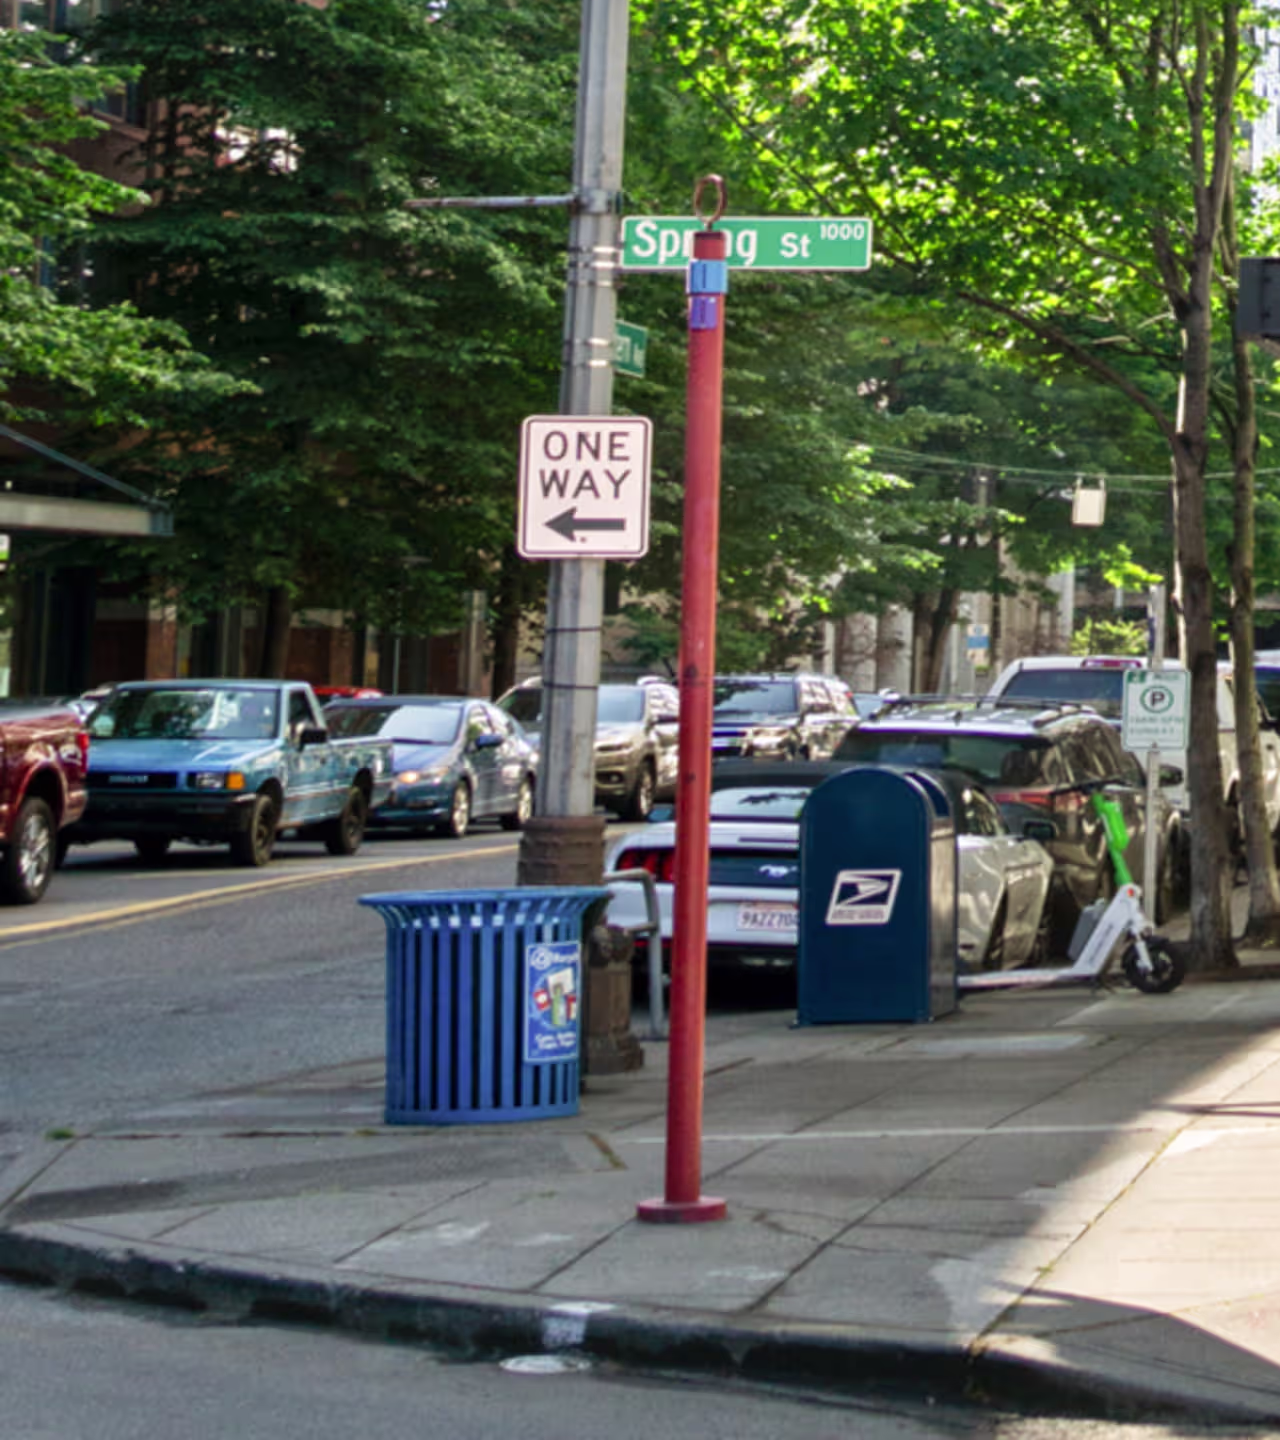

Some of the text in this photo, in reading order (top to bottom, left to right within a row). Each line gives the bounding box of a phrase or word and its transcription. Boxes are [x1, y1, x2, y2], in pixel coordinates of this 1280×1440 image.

[632, 220, 865, 266] Sprg St 1000
[543, 432, 630, 462] ONE
[539, 469, 631, 500] WAY
[1150, 691, 1165, 707] P
